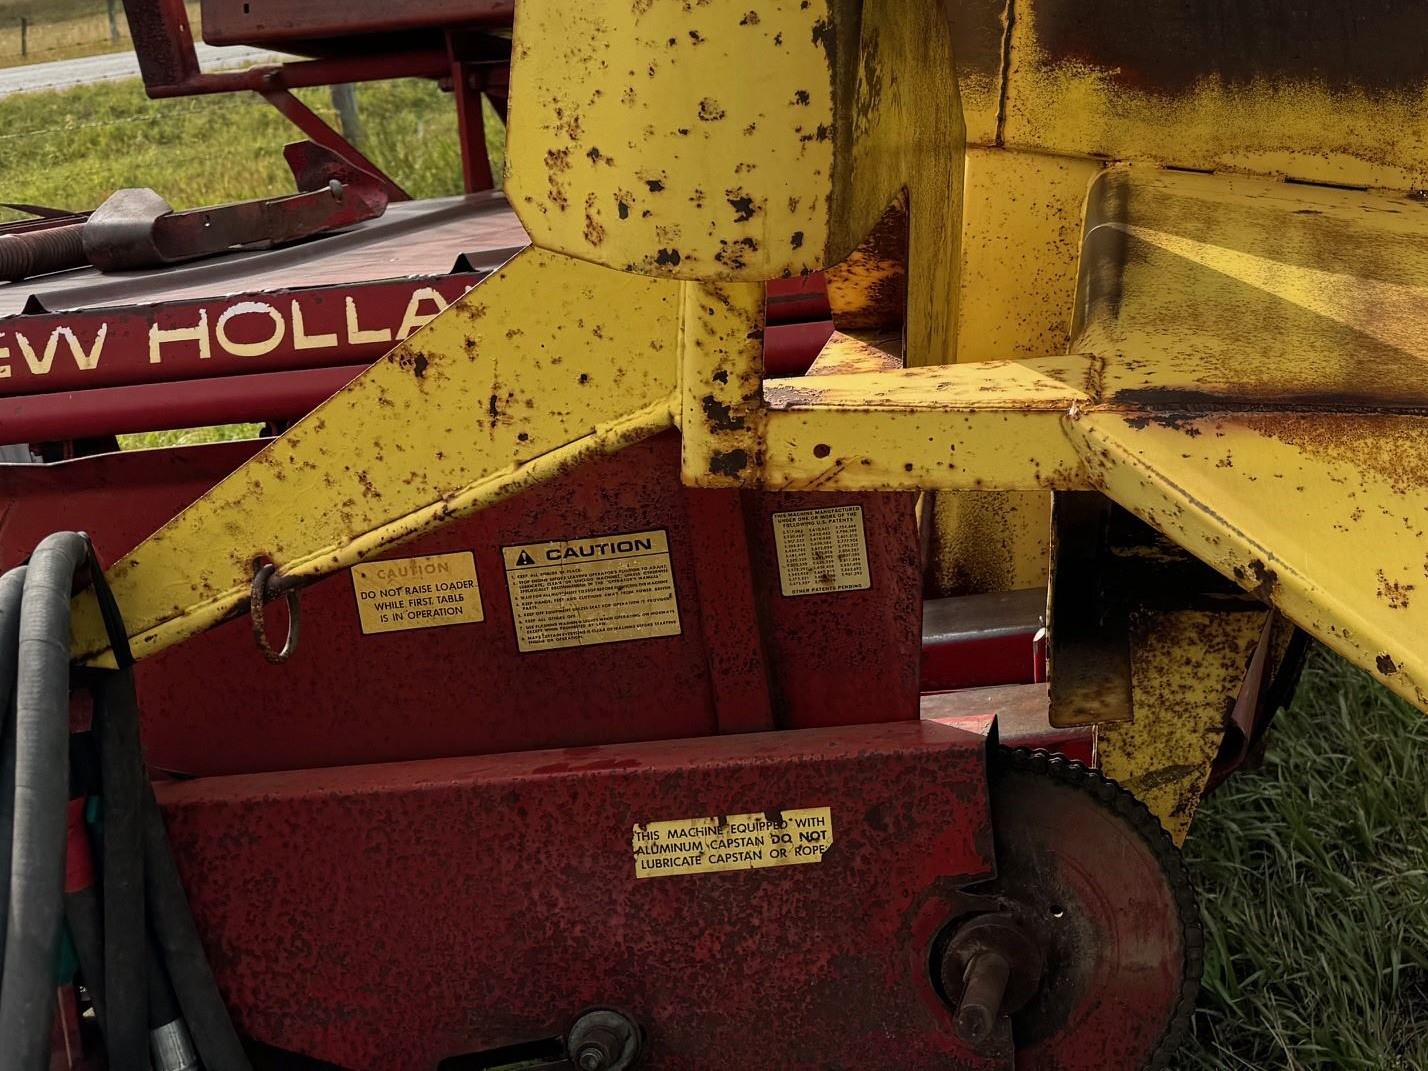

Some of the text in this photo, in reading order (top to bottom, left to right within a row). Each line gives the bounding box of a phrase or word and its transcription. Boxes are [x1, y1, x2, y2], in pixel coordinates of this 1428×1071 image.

[149, 285, 472, 363] HOLLA
[545, 538, 652, 560] CAUTION
[376, 561, 449, 580] CAUTION
[360, 578, 474, 600] DO NOT RAISE LOADER
[374, 592, 464, 611] WHILE FIRST TABLE
[380, 605, 463, 623] IS IN OPERATION
[636, 815, 825, 842] THIS MACHINE EQUIPPED WITH
[637, 829, 826, 856] ALUMINUM CAPSTAN DO NOT
[640, 855, 701, 870] LUBRICATE
[708, 849, 762, 864] CAPSTAN
[769, 847, 786, 858] OR
